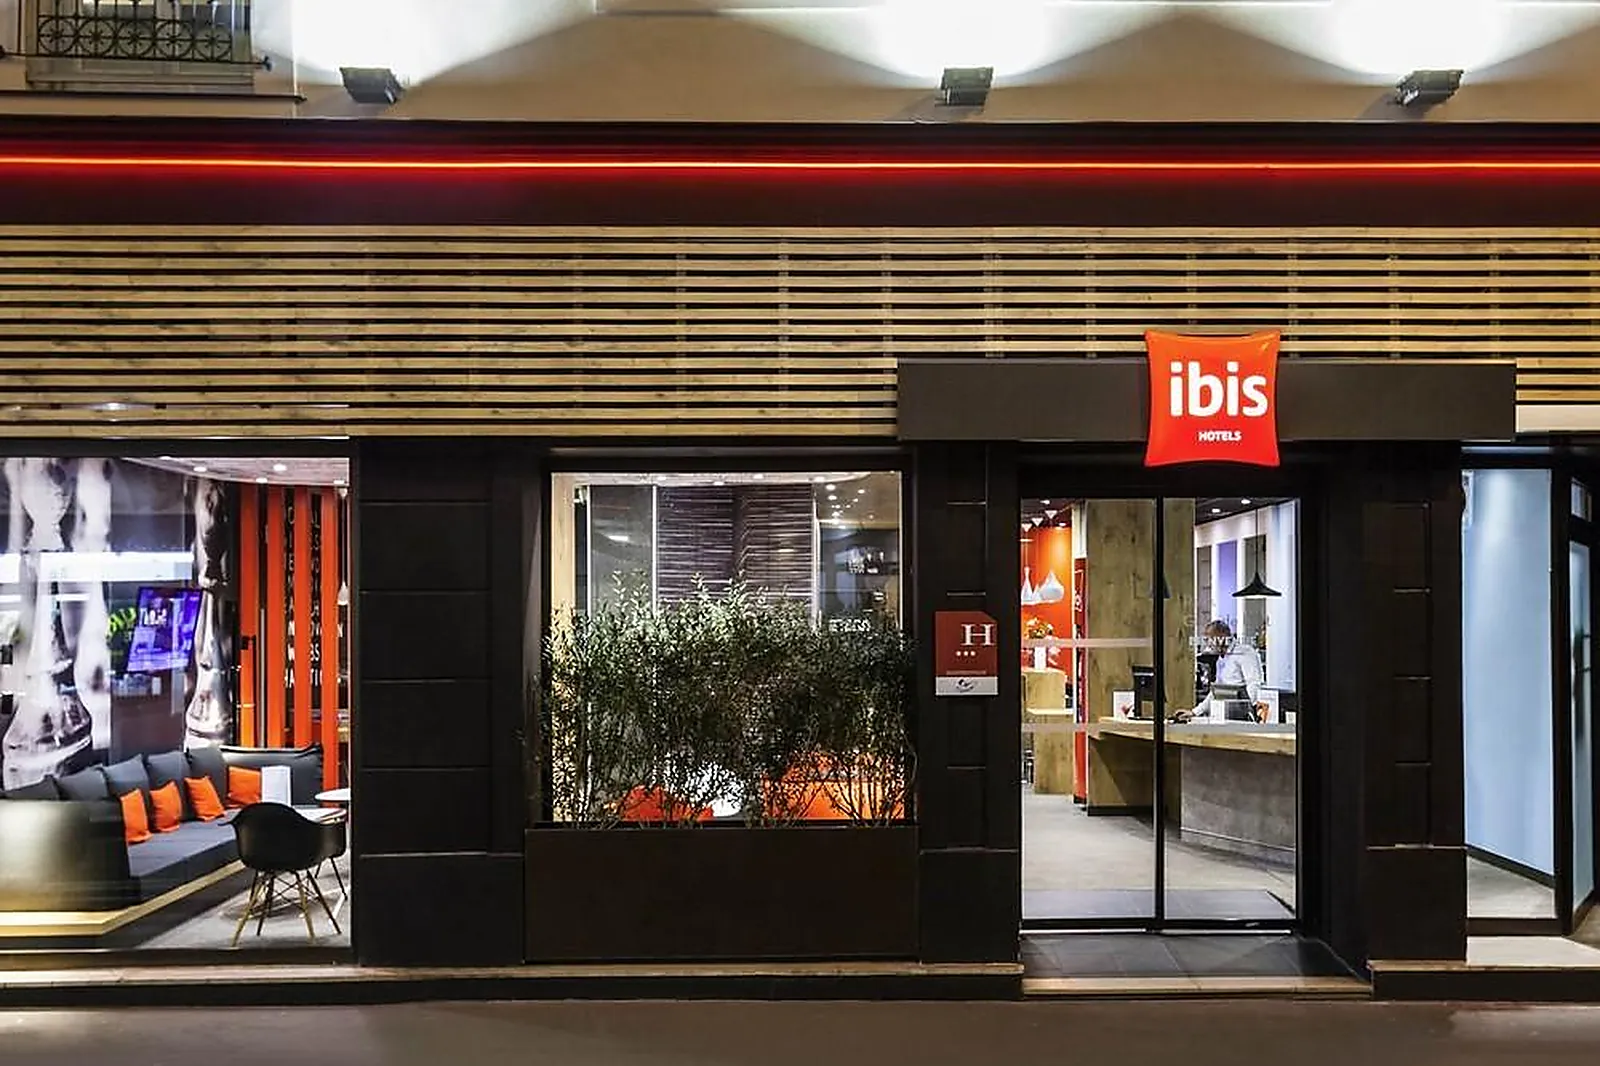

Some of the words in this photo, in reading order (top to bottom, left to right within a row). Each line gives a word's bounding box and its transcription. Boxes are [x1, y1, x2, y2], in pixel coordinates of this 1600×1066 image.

[1170, 361, 1268, 417] ibis
[1198, 430, 1242, 442] HOTELS
[960, 623, 996, 646] H
